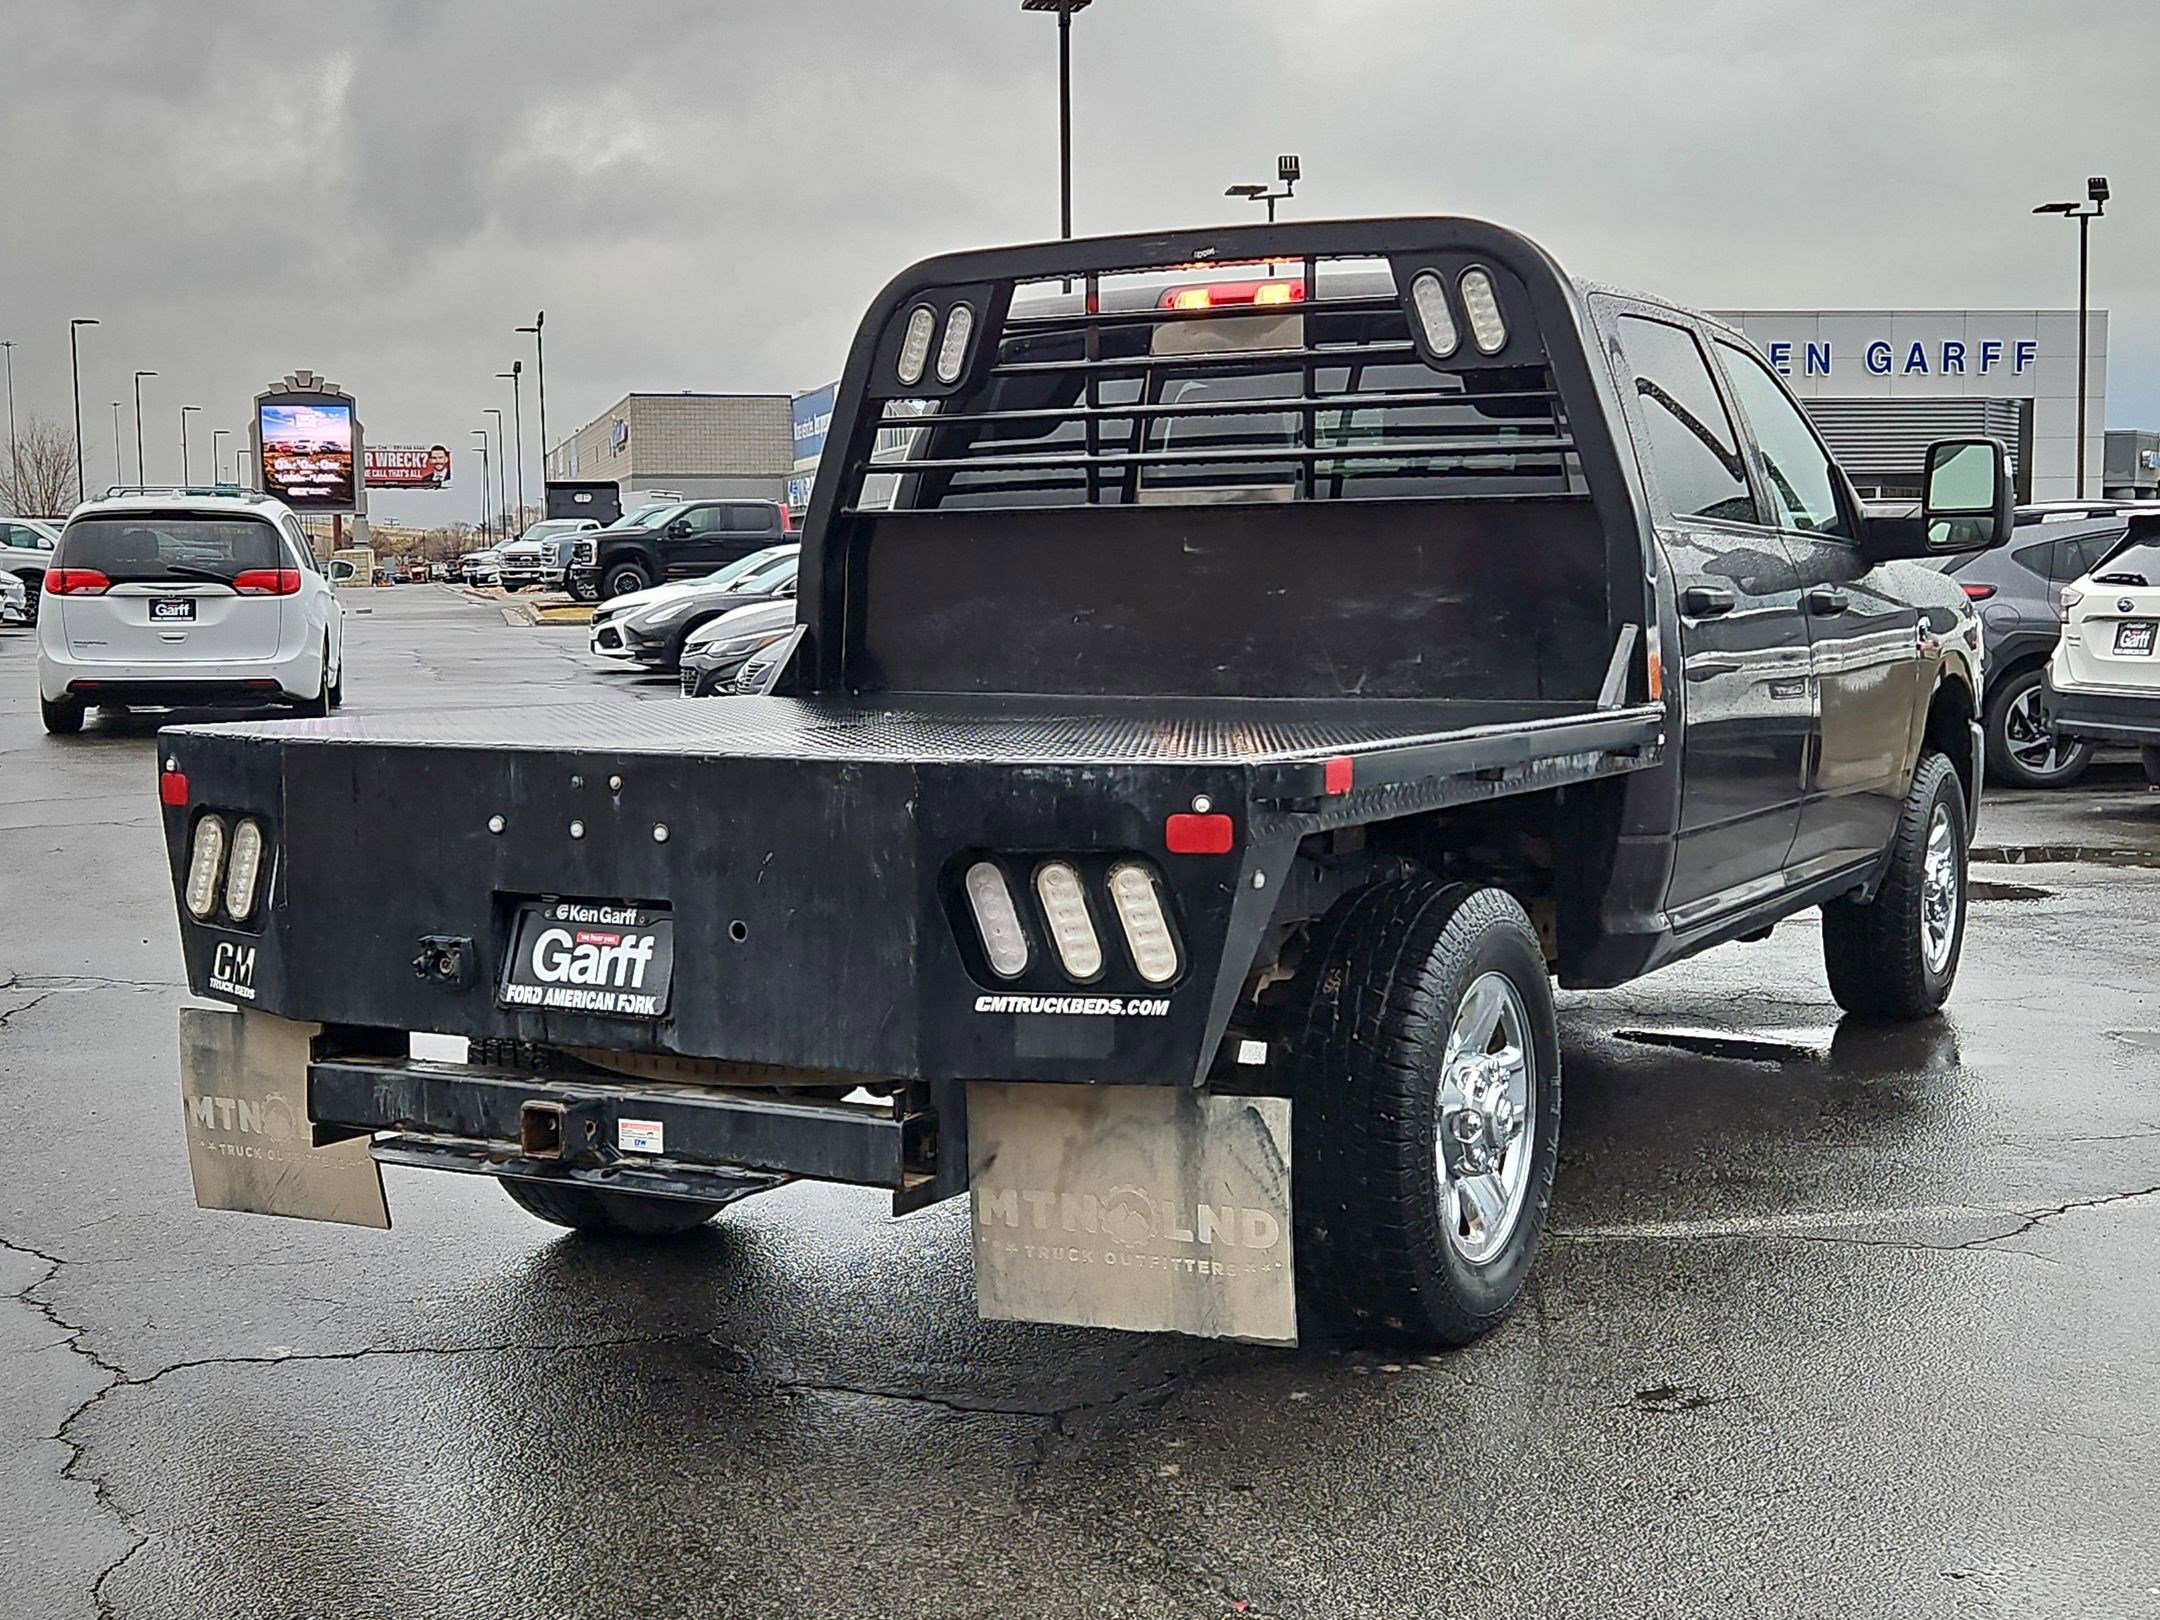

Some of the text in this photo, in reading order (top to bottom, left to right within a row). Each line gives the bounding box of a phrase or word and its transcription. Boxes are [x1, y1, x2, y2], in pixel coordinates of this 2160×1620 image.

[1769, 341, 2038, 376] EN GARFF
[375, 452, 428, 468] WRECK?
[372, 469, 387, 477] CALL
[411, 469, 422, 477] ALL
[156, 604, 190, 616] Garff
[2120, 630, 2152, 648] Garff
[569, 905, 637, 925] Ken Garff
[213, 942, 256, 986] CM
[532, 928, 655, 988] Garff
[210, 977, 256, 1000] TRUCK BEDS
[506, 983, 657, 1015] FORD AMERICAN FORK
[974, 996, 1171, 1016] CMTRUCKBEDS.COM
[187, 1095, 263, 1134] MTN
[219, 1143, 263, 1160] TRUCK
[977, 1187, 1280, 1249] MTN LND
[1025, 1246, 1238, 1278] TRUCK OUTFITTERS
